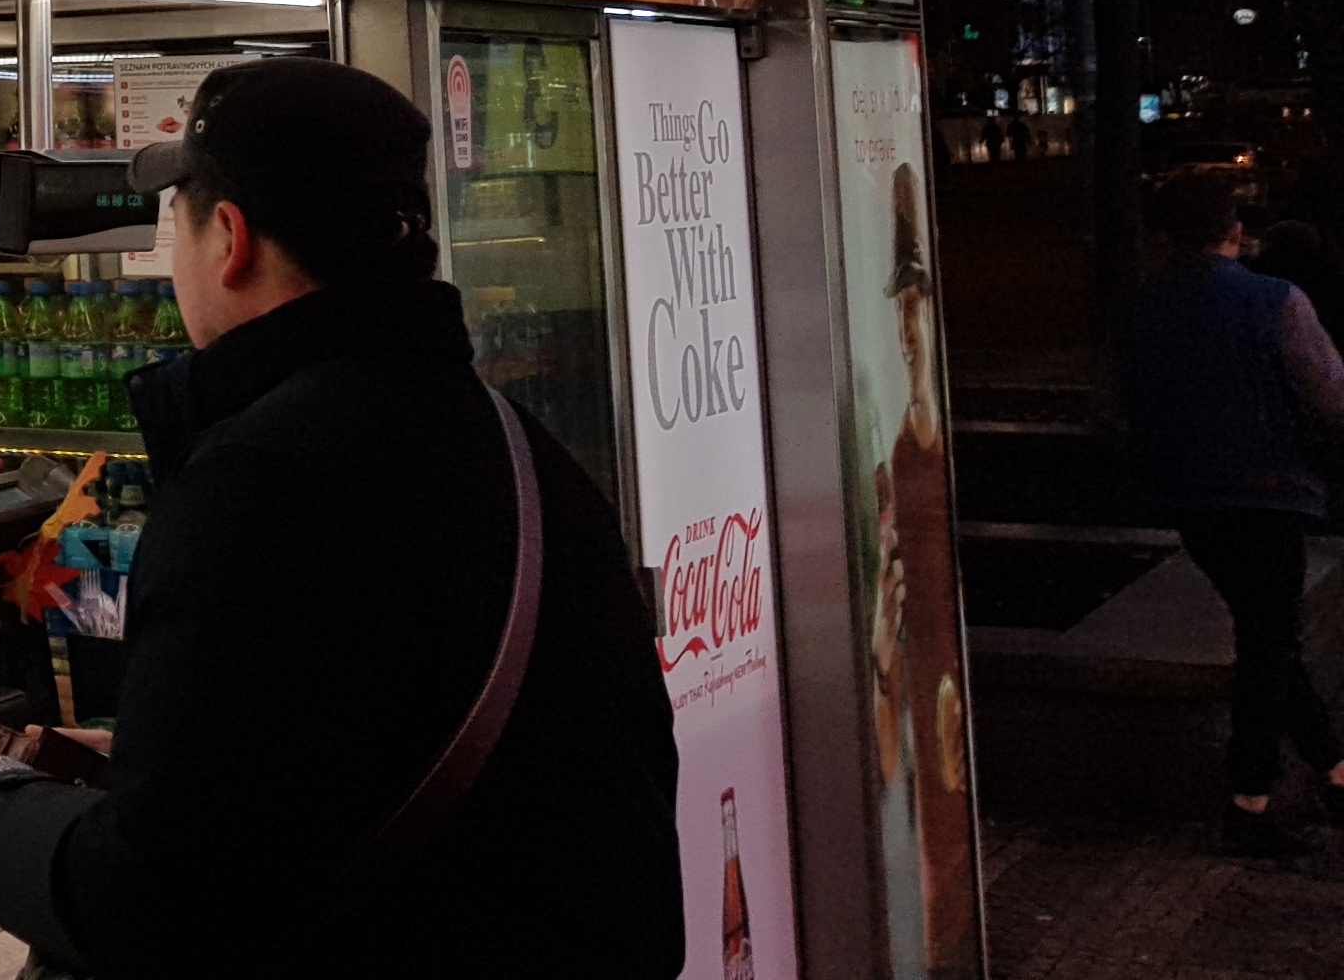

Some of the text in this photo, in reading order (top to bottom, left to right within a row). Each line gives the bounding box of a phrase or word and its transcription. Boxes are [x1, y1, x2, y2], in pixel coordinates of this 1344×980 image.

[649, 99, 730, 164] Things Go
[634, 151, 713, 225] Better
[664, 224, 736, 310] With
[648, 296, 746, 431] Coke
[685, 516, 716, 545] DRINK
